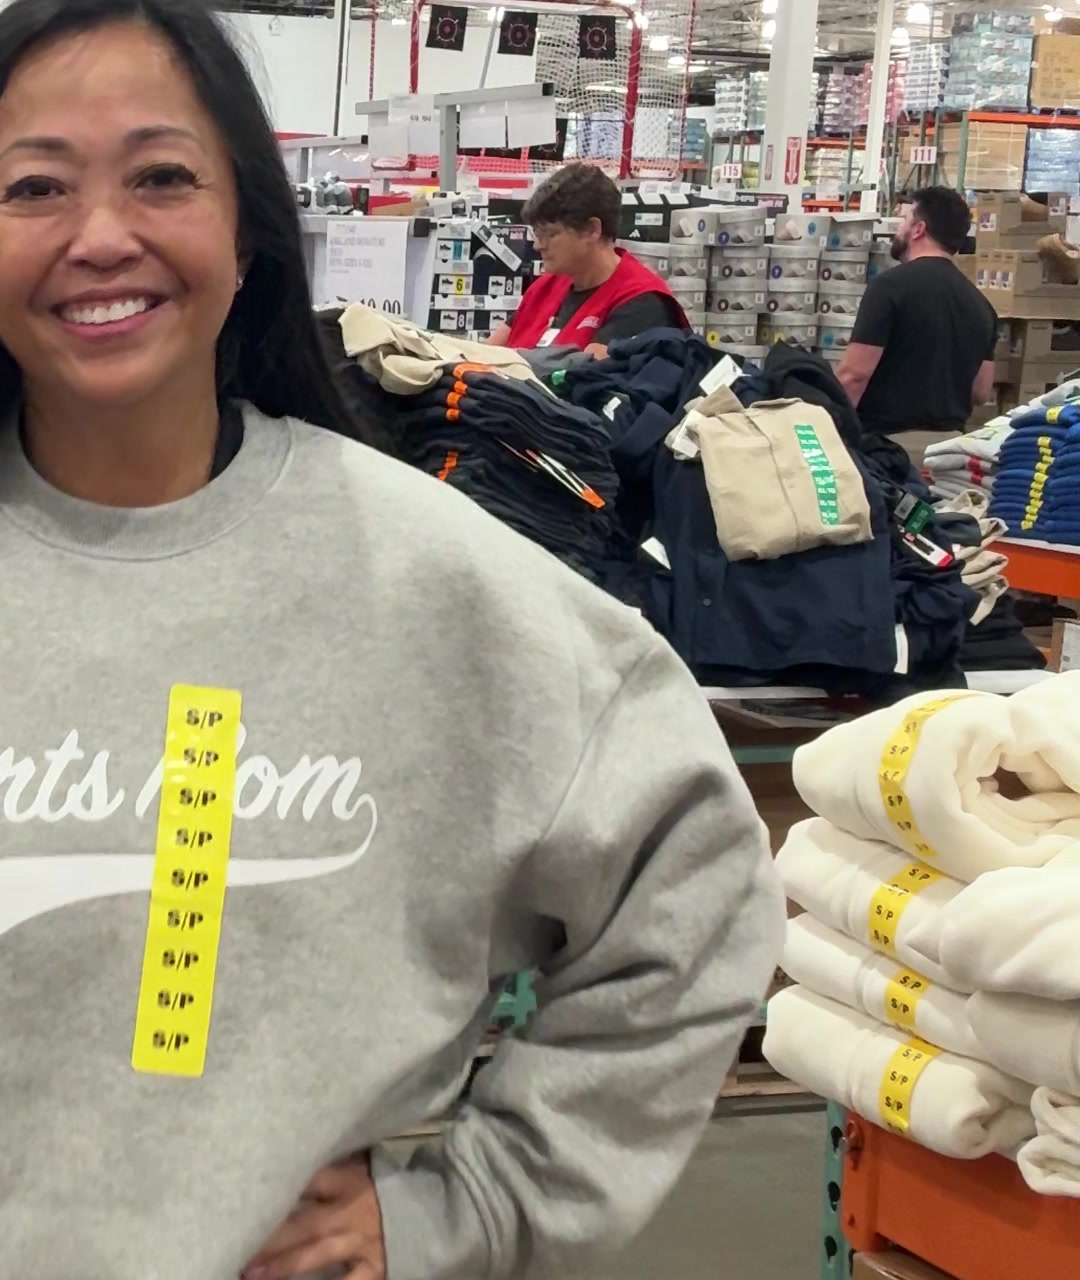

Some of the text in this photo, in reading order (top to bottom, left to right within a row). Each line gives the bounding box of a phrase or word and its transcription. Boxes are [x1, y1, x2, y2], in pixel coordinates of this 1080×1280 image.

[914, 149, 932, 162] 111
[722, 166, 739, 177] 115
[186, 709, 223, 729] S/P
[183, 748, 219, 768] S/P
[135, 722, 377, 821] om
[179, 788, 217, 808] S/P
[175, 828, 212, 849] S/P
[171, 869, 208, 891] S/P
[909, 868, 930, 881] S/P
[167, 909, 204, 930] S/P
[876, 904, 894, 920] S/P
[162, 949, 199, 970] S/P
[900, 975, 922, 990] S/P
[157, 989, 194, 1011] S/P
[891, 997, 910, 1014] S/P
[152, 1030, 189, 1052] S/P
[903, 1048, 922, 1061] S/P
[890, 1071, 908, 1085] S/P
[885, 1096, 903, 1111] S/P
